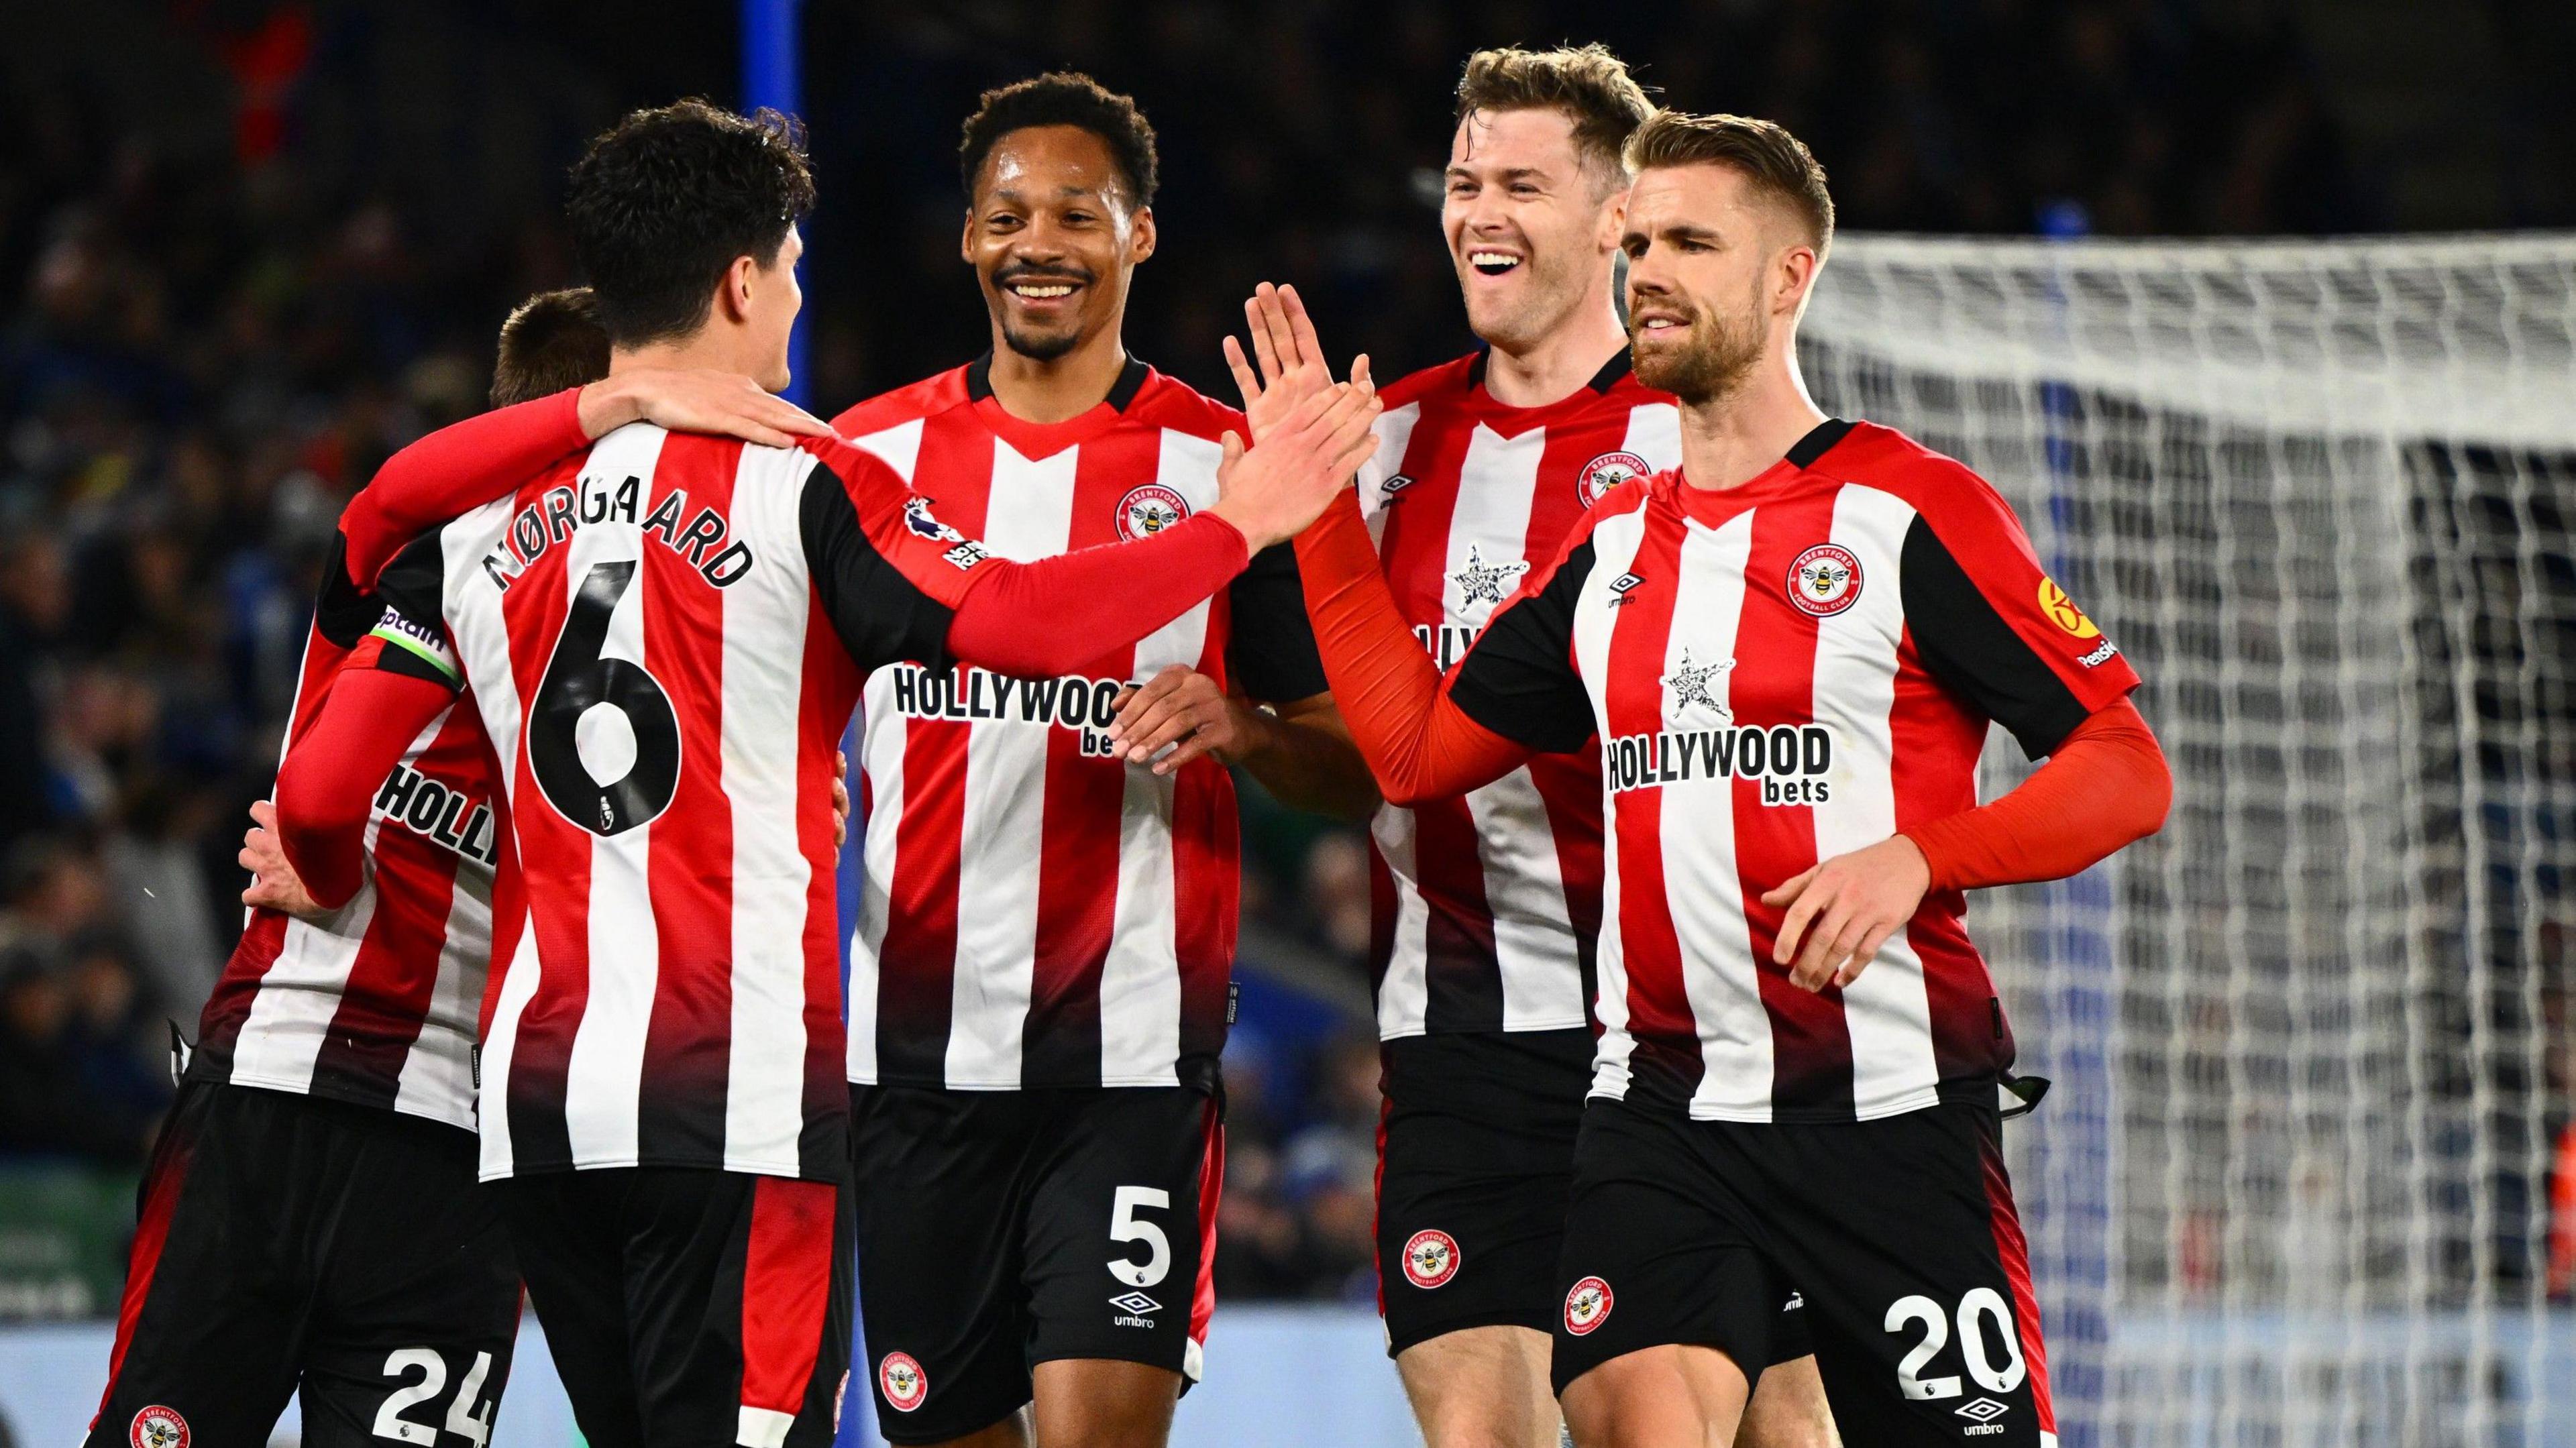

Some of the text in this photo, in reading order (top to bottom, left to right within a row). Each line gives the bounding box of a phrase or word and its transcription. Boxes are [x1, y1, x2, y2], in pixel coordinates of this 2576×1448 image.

[1591, 456, 1644, 472] BRENTFORD
[1128, 490, 1181, 510] BRENTFORD
[482, 476, 753, 591] NØRGAARD
[1799, 549, 1853, 567] BRENTFORD
[1794, 594, 1828, 611] FOOTBALL
[1830, 596, 1849, 609] CLUB
[379, 611, 445, 652] ptain
[529, 560, 680, 834] 6
[894, 668, 1142, 728] HOLLYWOO
[1083, 726, 1114, 755] be
[1607, 728, 1831, 791] HOLLYWOOD
[1765, 775, 1829, 803] bets
[1107, 1186, 1171, 1287] 5
[1408, 1234, 1449, 1252] BRENTFORD
[1114, 1315, 1155, 1329] umbro
[1884, 1288, 2026, 1400] 20
[372, 1349, 492, 1448] 24
[146, 1409, 185, 1433] BRENTFORD
[1964, 1423, 2004, 1436] umbro
